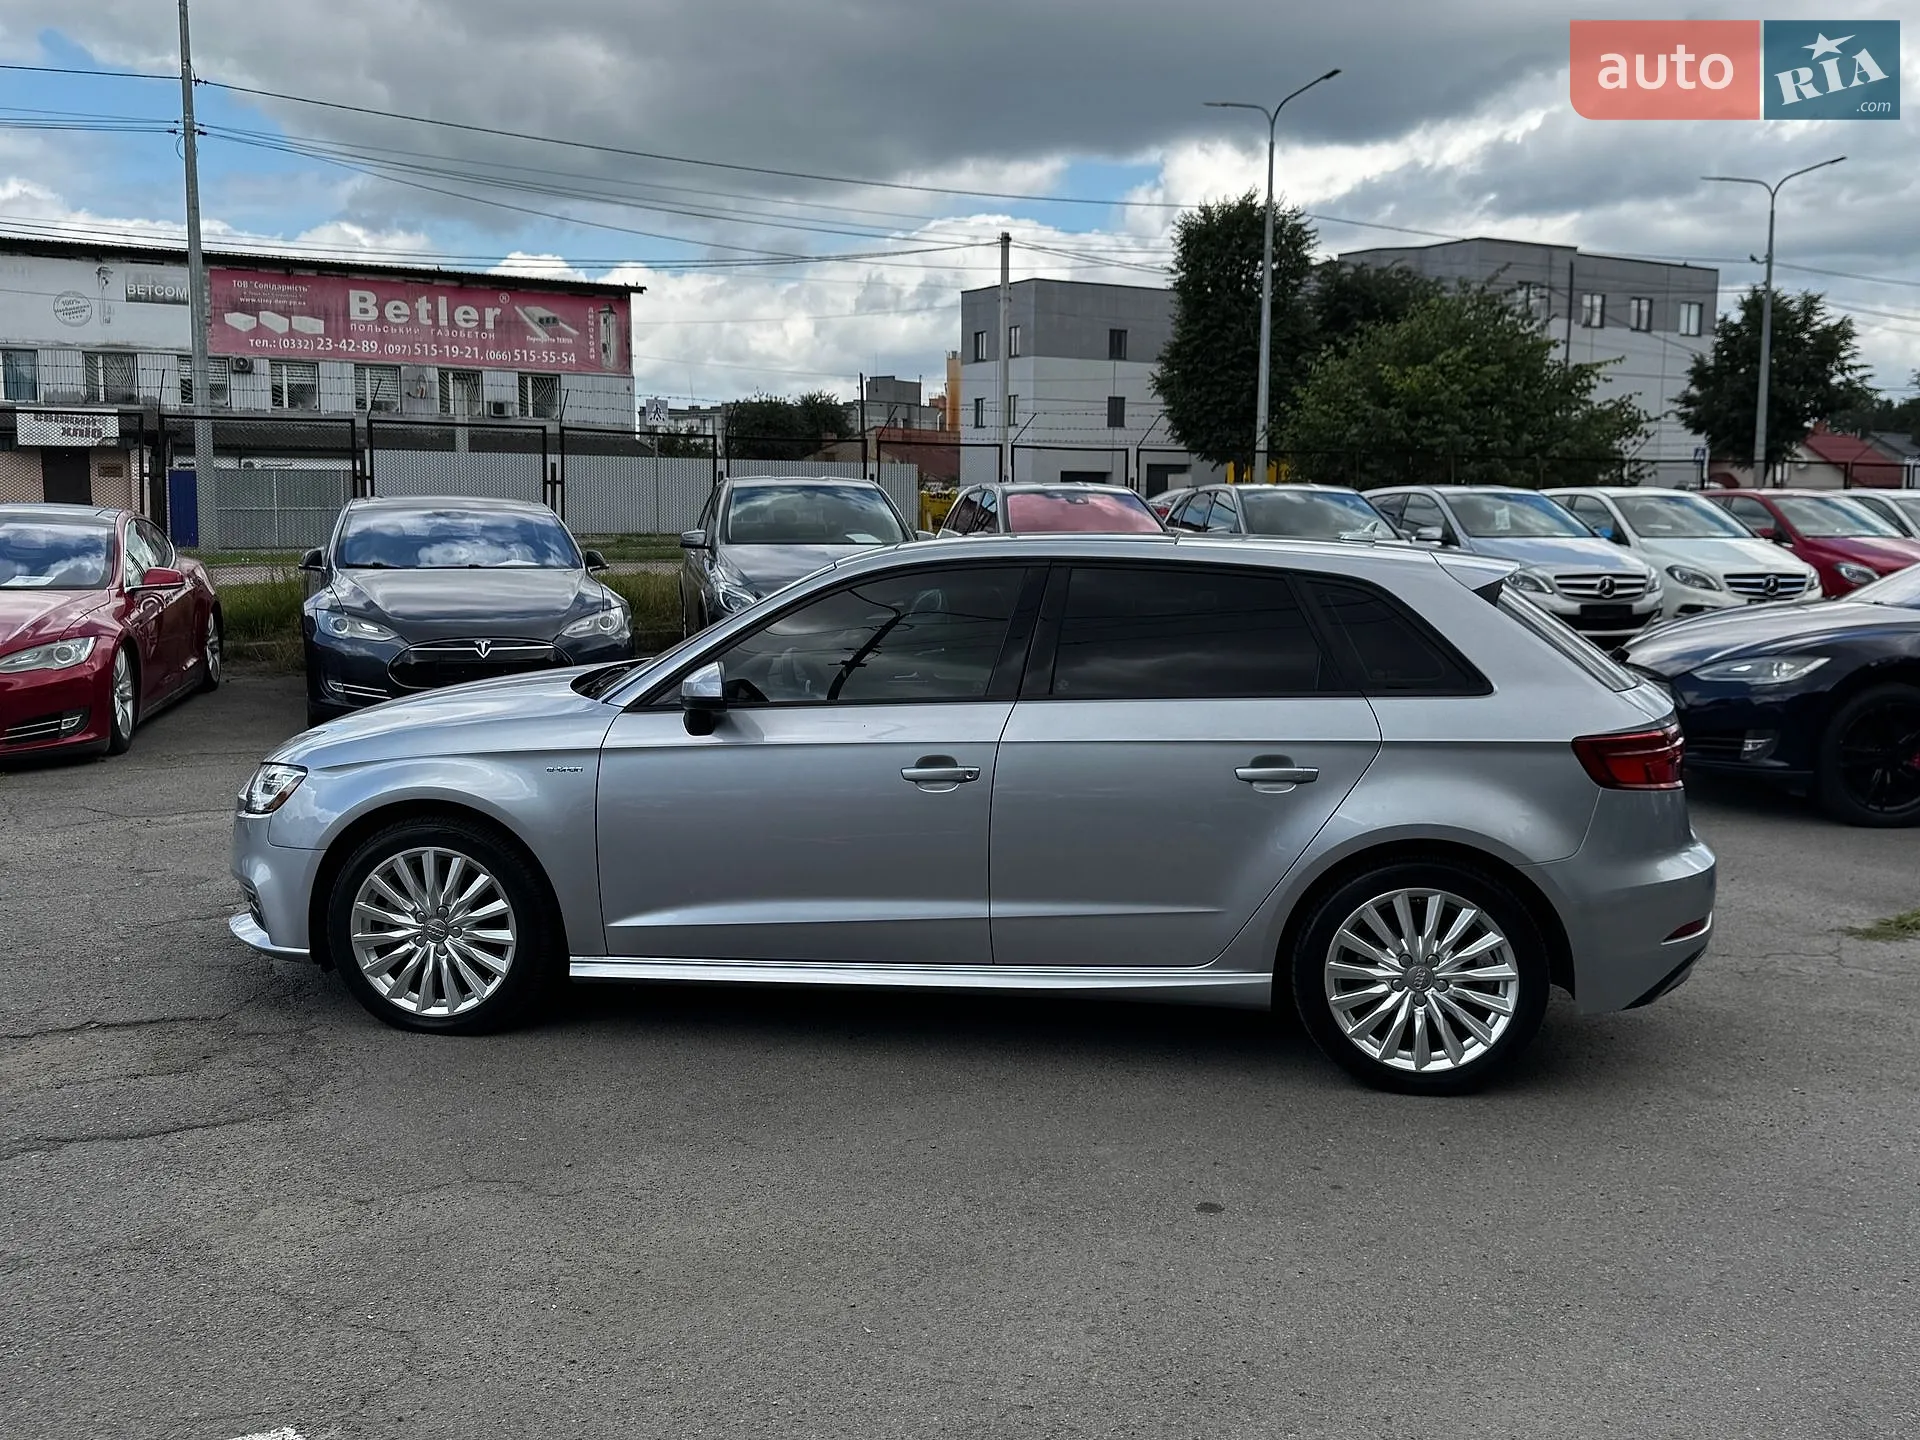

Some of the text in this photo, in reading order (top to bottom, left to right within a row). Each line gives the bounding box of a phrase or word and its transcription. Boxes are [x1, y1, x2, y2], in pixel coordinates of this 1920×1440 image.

[127, 283, 188, 299] BETCOM
[232, 279, 249, 289] ТОВ
[349, 289, 502, 330] Betler
[430, 328, 496, 341] ГАЗОБЕТОН
[249, 338, 276, 349] тел.:
[278, 338, 315, 351] (0332)
[384, 346, 412, 356] (097)
[485, 350, 512, 362] (066)
[513, 348, 577, 365] 515-55-54
